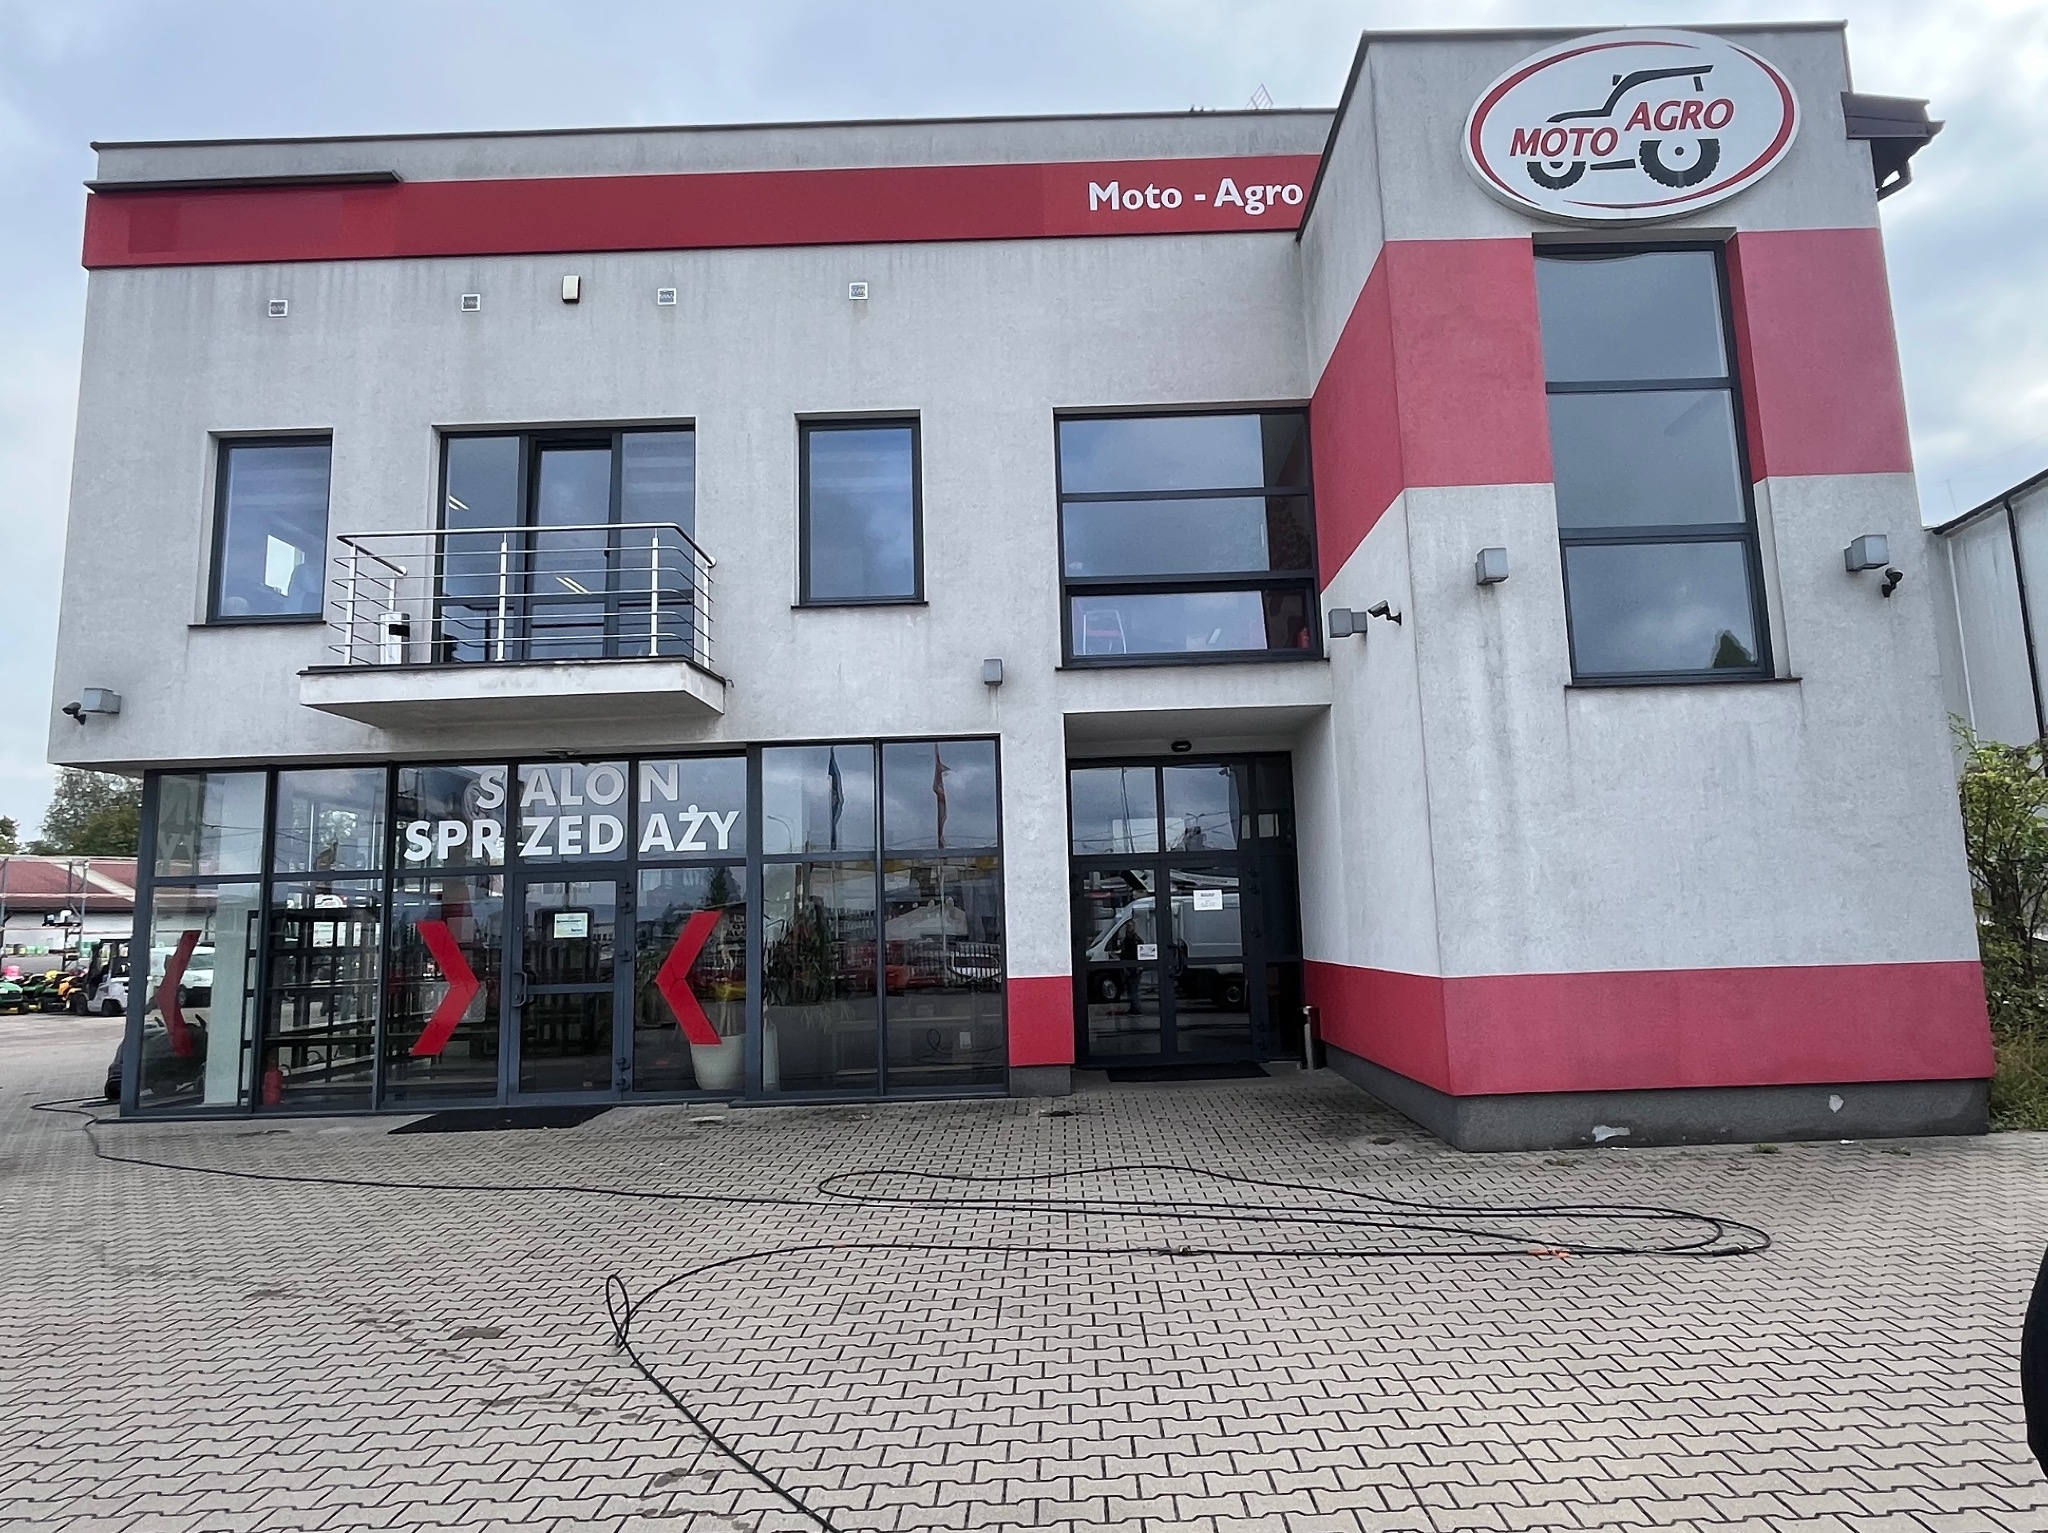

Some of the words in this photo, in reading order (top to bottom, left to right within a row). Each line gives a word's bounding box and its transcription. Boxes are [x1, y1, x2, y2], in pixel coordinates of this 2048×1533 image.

[1510, 127, 1619, 157] MOTO
[1624, 99, 1735, 131] AGRO
[1088, 181, 1183, 211] Moto
[1213, 178, 1304, 215] Agro
[476, 763, 680, 809] SALON
[404, 804, 740, 861] SPRZEDAŻY
